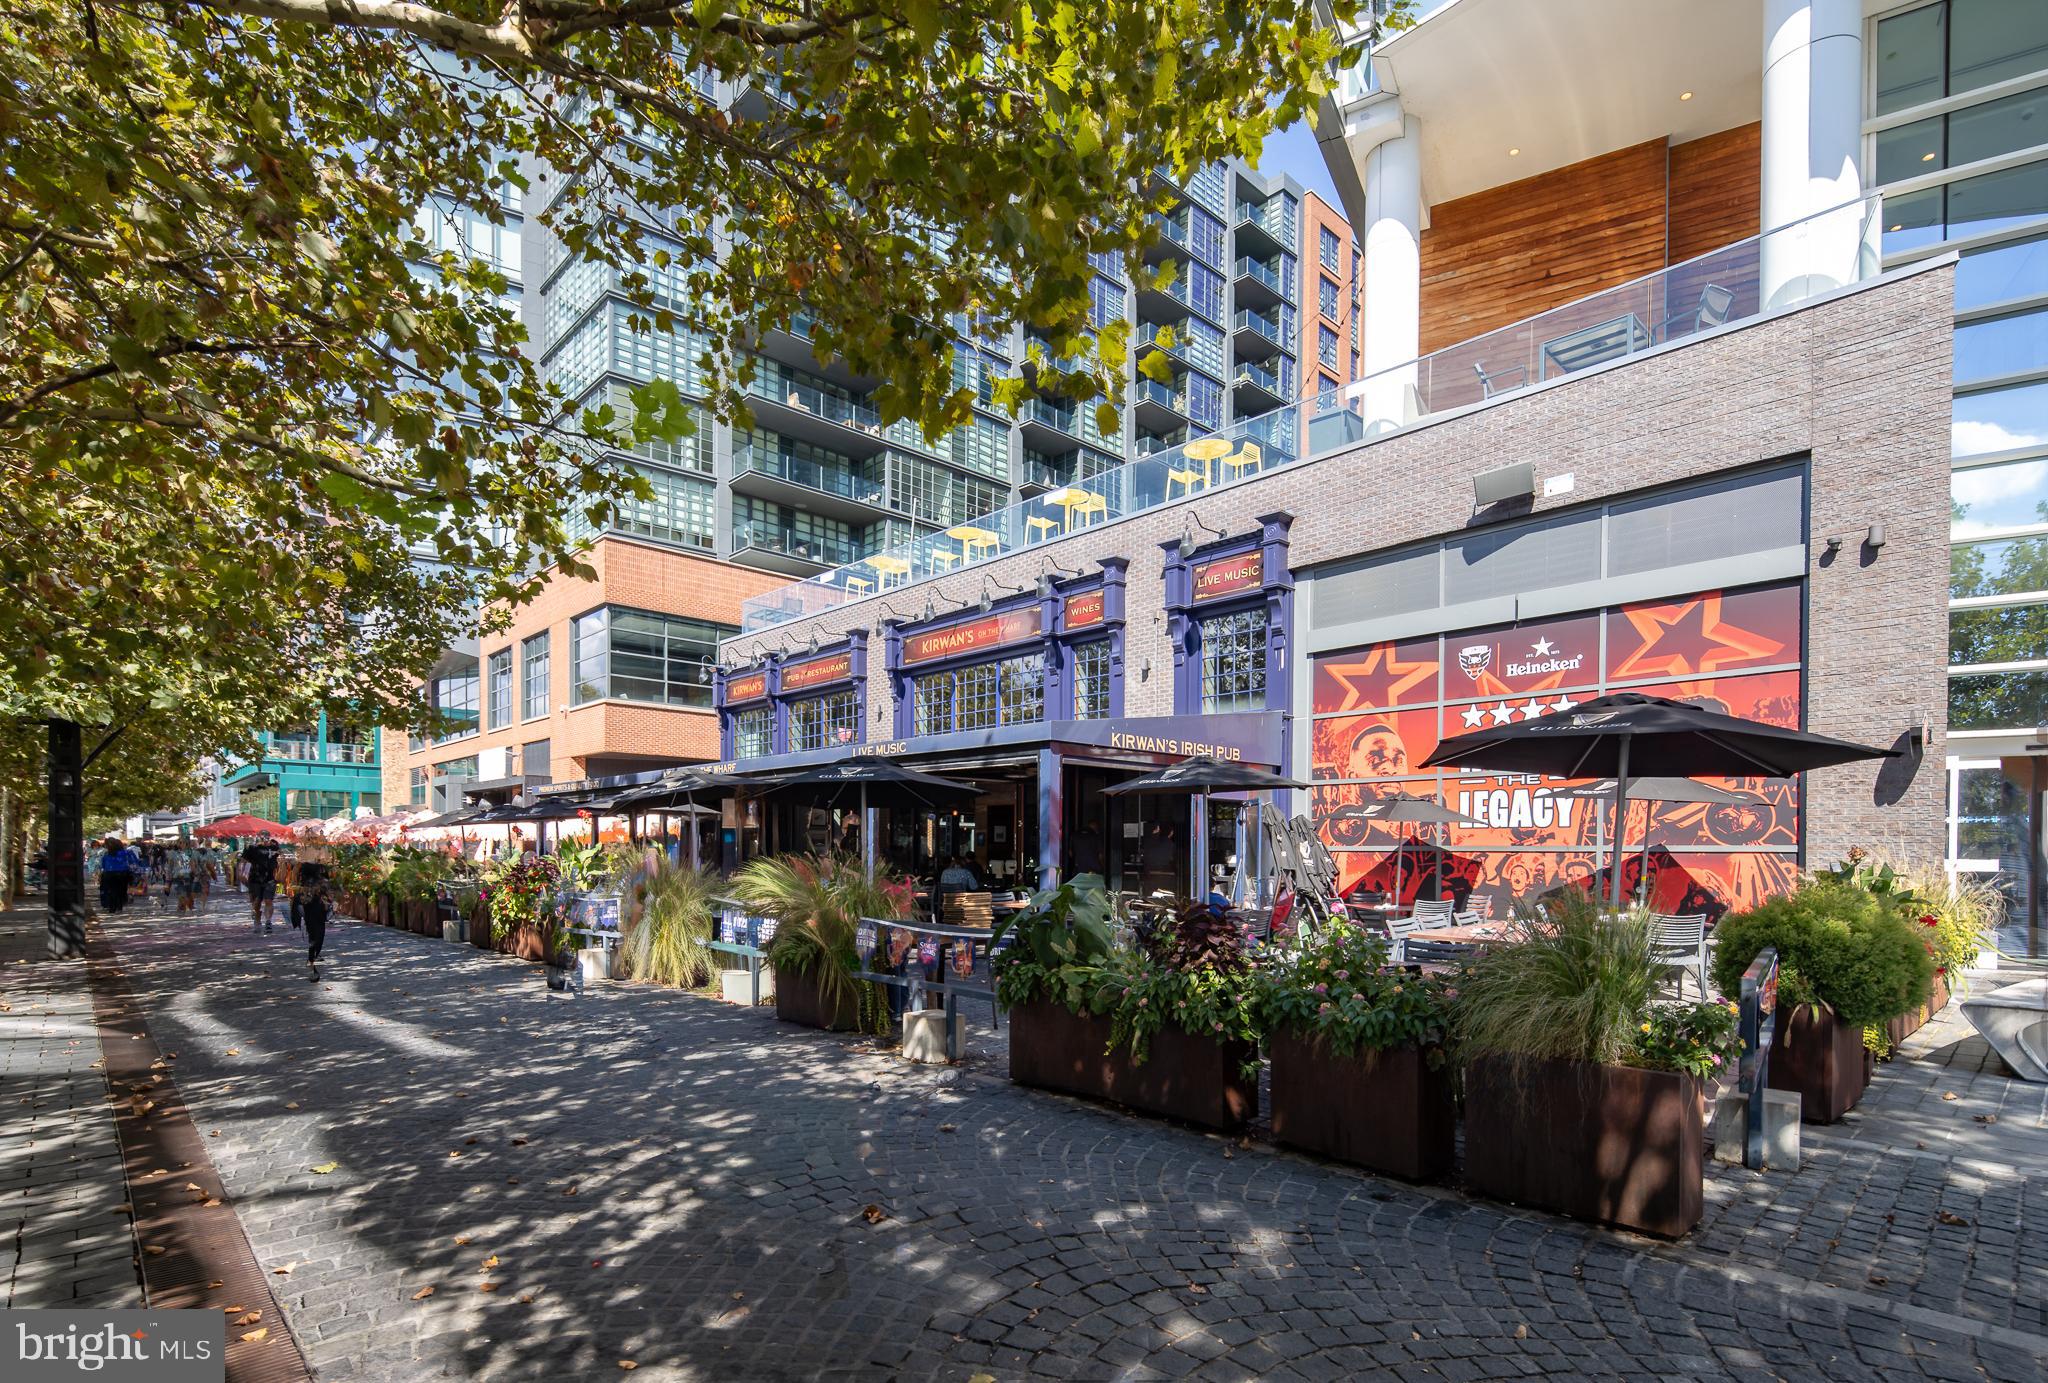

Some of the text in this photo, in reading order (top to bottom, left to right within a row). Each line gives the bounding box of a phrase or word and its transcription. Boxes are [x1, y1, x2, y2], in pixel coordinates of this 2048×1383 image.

[1198, 565, 1259, 588] LIVE MUSIC
[1071, 603, 1100, 617] WINES
[922, 630, 974, 654] KIRWAN'S
[787, 674, 799, 684] PUB
[808, 662, 848, 678] RESTAURANT
[1506, 658, 1580, 677] Heineken
[733, 681, 762, 697] KIRWAN'S
[1530, 722, 1631, 731] GUINNESS
[852, 742, 907, 757] LIVE MUSIC
[1111, 732, 1240, 761] KIRWAN'S IRISH PUB
[713, 763, 736, 775] WHARF
[1494, 774, 1541, 786] THE
[1458, 788, 1574, 829] LEGACY
